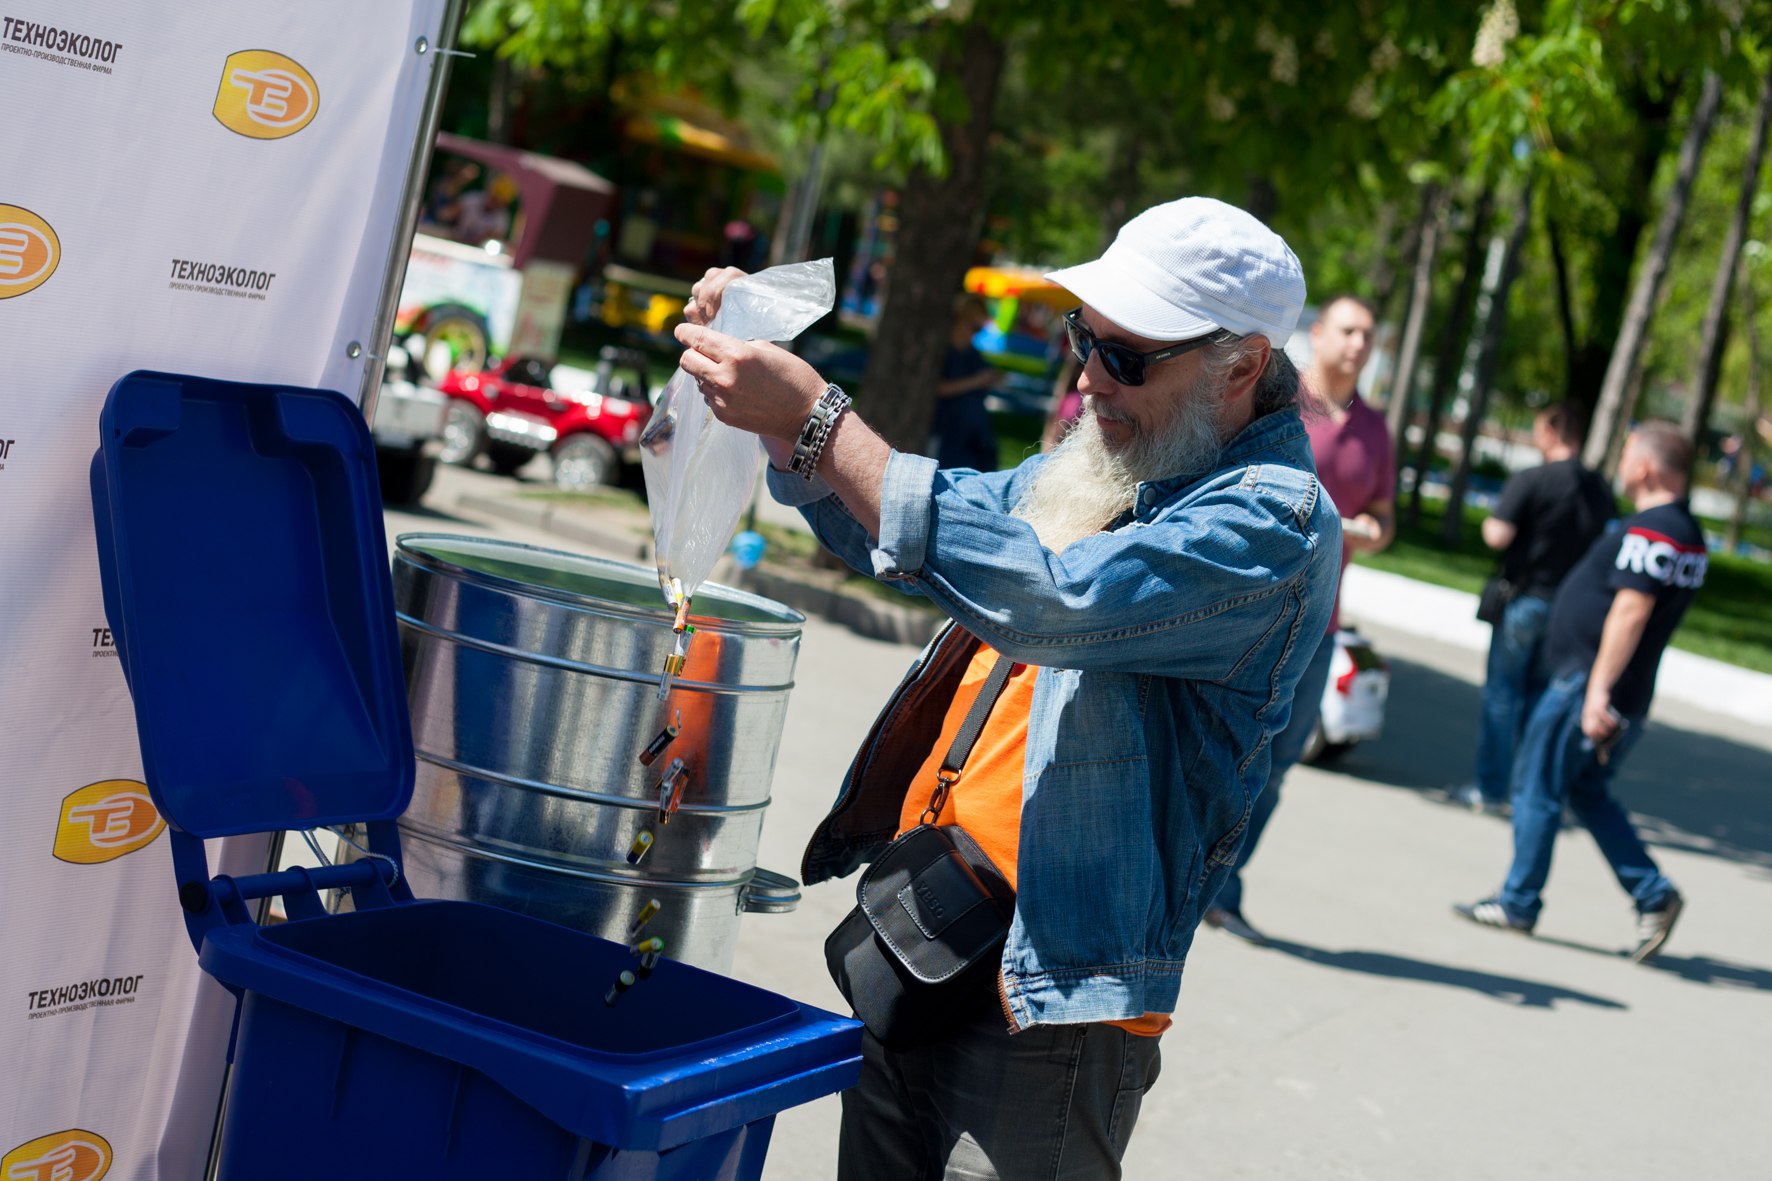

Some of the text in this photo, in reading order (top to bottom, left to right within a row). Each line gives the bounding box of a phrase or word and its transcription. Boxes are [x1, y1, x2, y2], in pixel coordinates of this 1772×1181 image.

[3, 17, 123, 63] ТЕХНОЭКОЛОГ
[1, 43, 113, 75] ПРОЕКТНО-ПРОИЗВОДСТВЕННАЯ ФИРМА
[170, 259, 276, 291] ТЕХНОЭКОЛОГ
[92, 628, 115, 647] ТЕ
[28, 975, 144, 1010] ТЕХНОЭКОЛОГ
